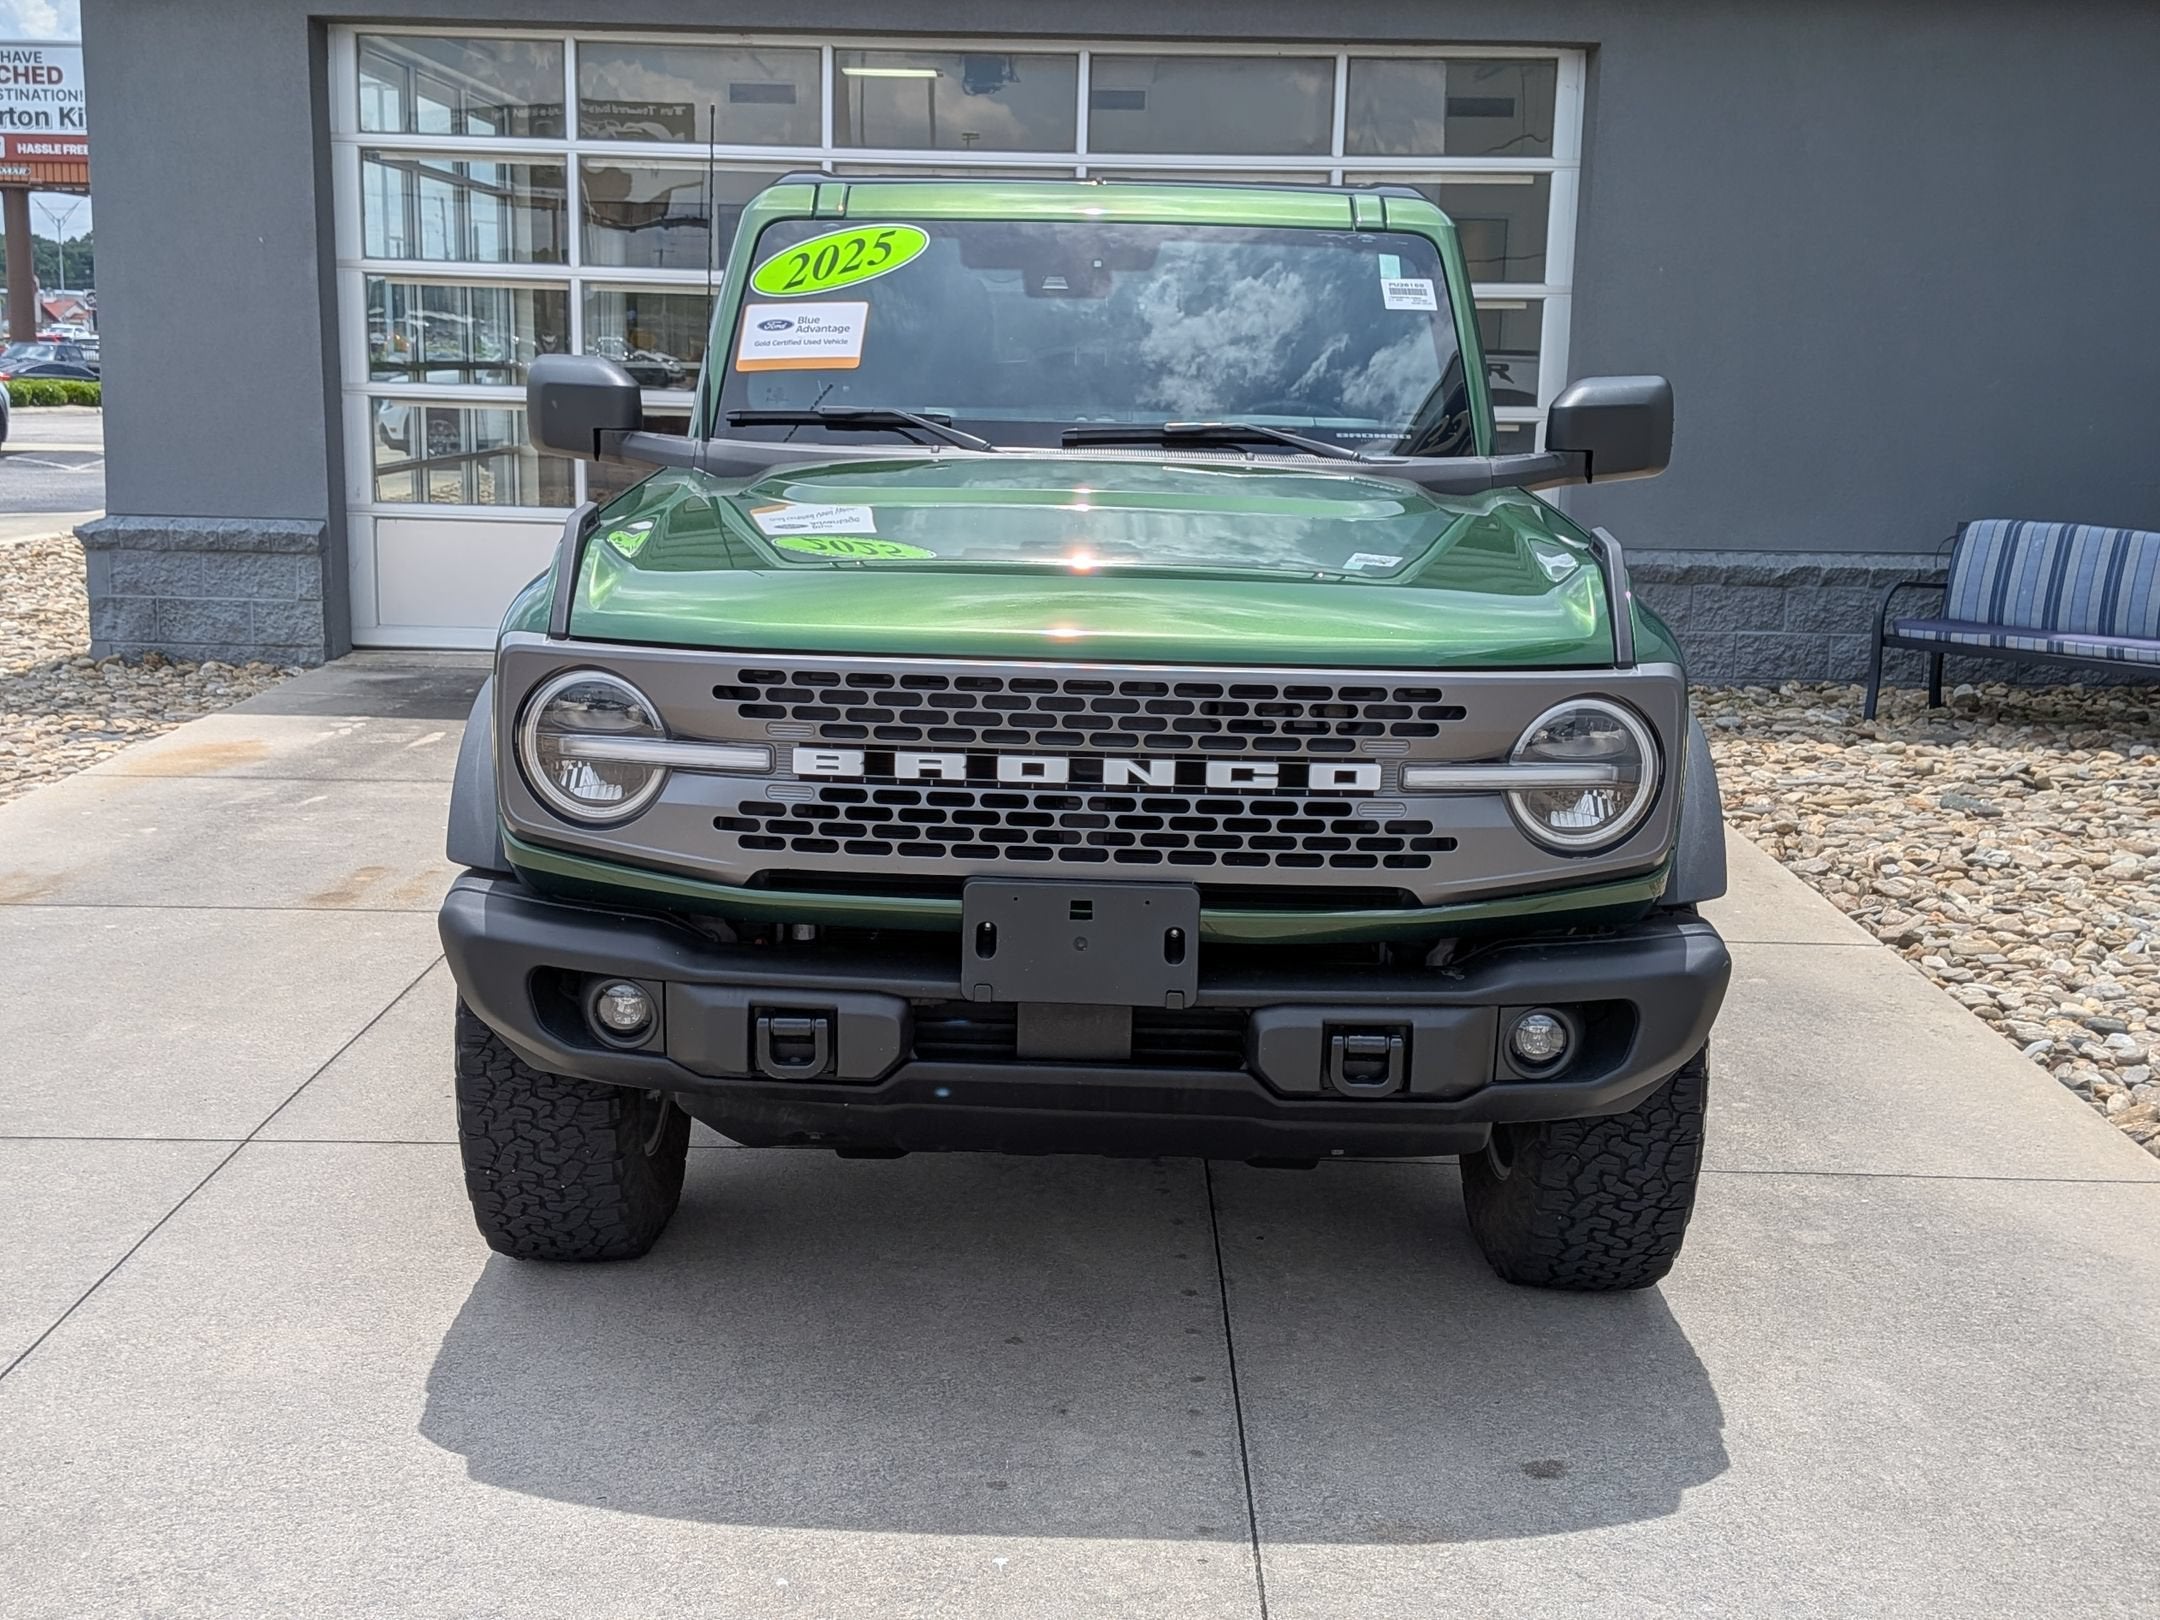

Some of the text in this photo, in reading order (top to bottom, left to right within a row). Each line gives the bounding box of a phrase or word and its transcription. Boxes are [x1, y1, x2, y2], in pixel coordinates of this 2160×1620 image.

[0, 50, 43, 64] HAVE
[0, 65, 64, 85] CHED
[16, 143, 62, 155] HASSLE
[782, 231, 896, 290] 2025
[763, 320, 789, 331] Ford
[797, 316, 821, 325] Blue
[795, 325, 851, 334] Advantage
[754, 338, 849, 347] Gold Certified Used Vehicle
[792, 747, 1382, 791] BRONCO
